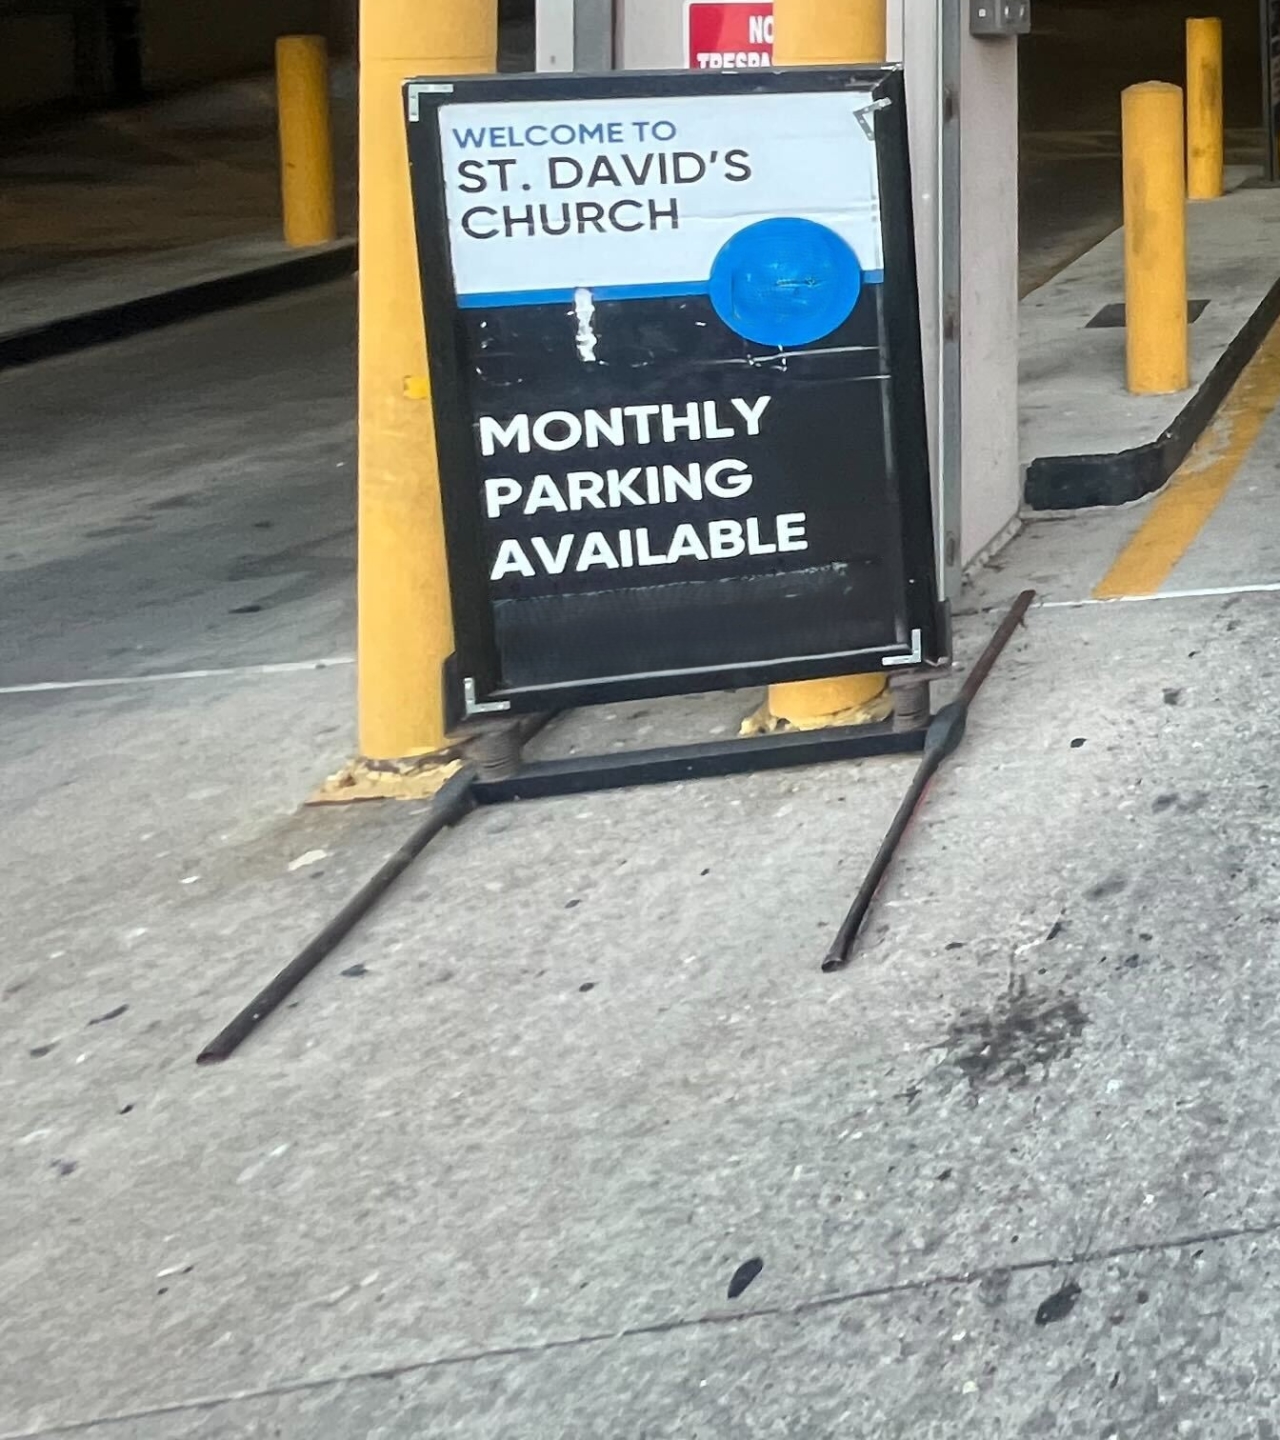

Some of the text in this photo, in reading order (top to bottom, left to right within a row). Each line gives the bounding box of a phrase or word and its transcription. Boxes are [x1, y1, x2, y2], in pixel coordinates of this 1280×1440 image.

[749, 15, 774, 44] NO
[452, 120, 677, 149] WELCOME TO
[458, 148, 753, 194] ST. DAVID'S
[460, 197, 679, 240] CHURCH
[478, 395, 772, 457] MONTHLY
[484, 458, 754, 519] PARKING
[490, 512, 809, 581] AVAILABLE
